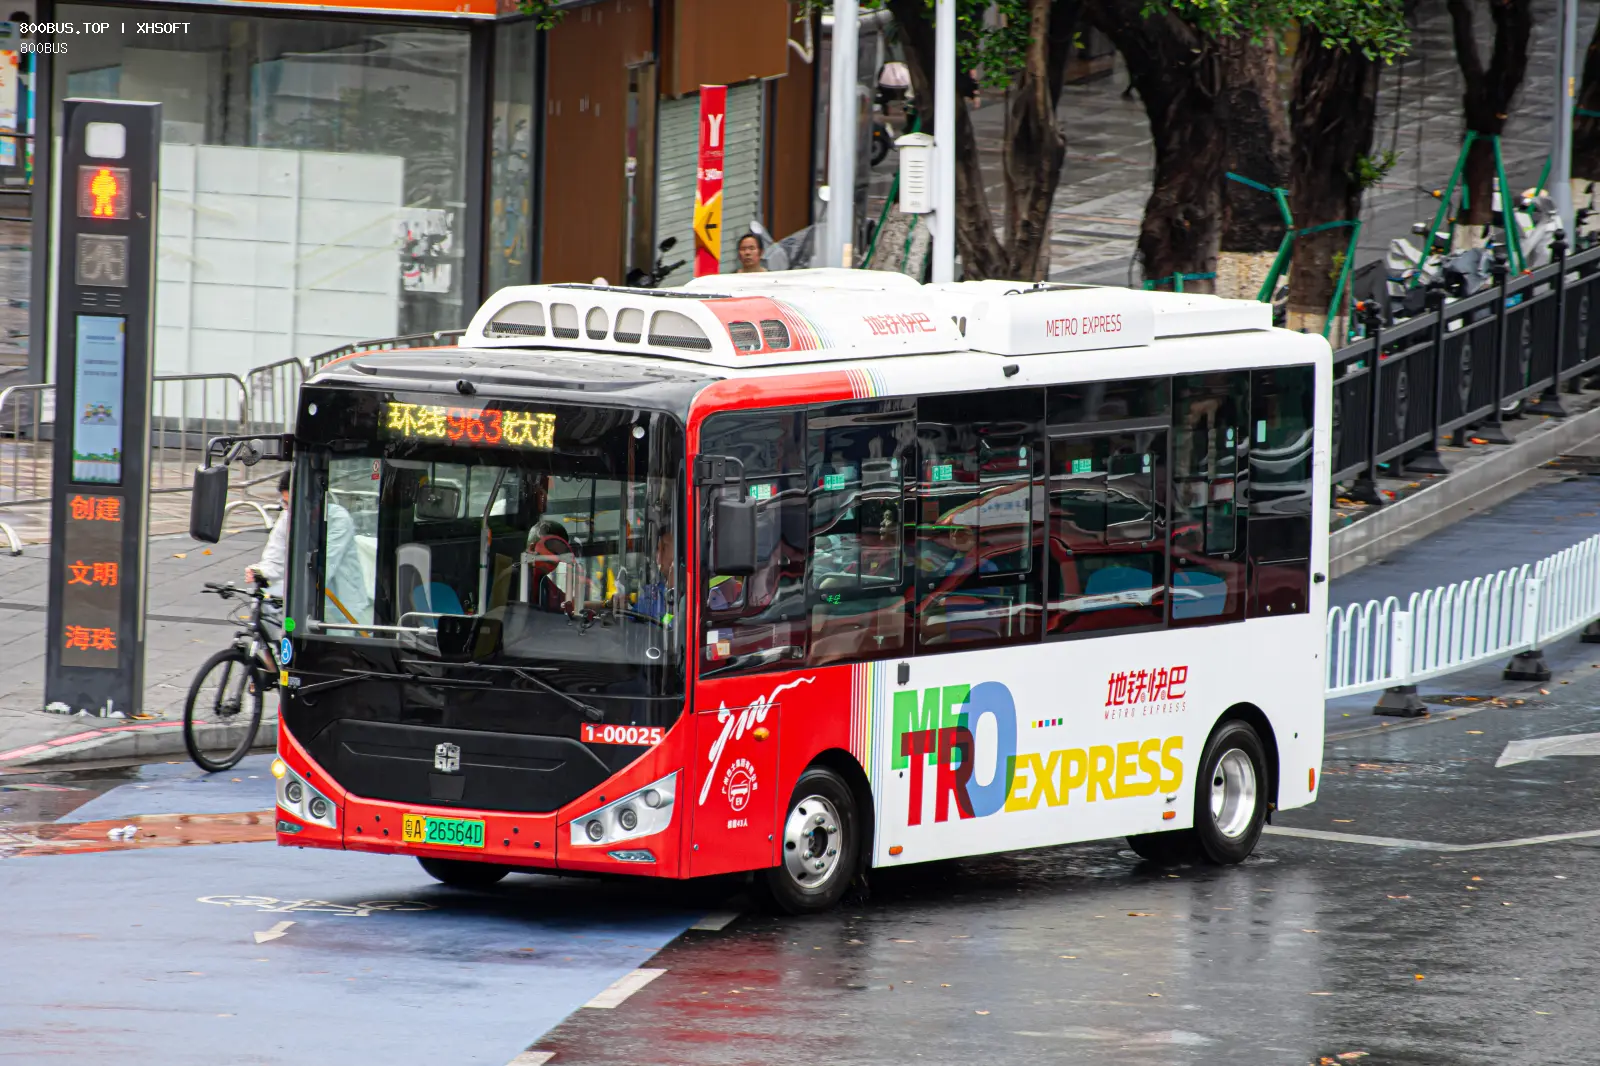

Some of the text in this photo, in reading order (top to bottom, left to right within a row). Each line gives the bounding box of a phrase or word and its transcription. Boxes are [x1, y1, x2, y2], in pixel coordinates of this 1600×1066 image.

[862, 312, 937, 336] 地铁快巴
[1046, 313, 1122, 338] METRO EXPRESS
[69, 494, 121, 522] 创建
[67, 559, 119, 587] 文明
[64, 625, 117, 651] 海珠
[1104, 665, 1188, 707] 地铁快巴
[1104, 701, 1187, 721] METRO EXPRESS
[586, 725, 662, 745] 1-00025
[1004, 736, 1184, 813] EXPRESS
[735, 796, 744, 806] EV
